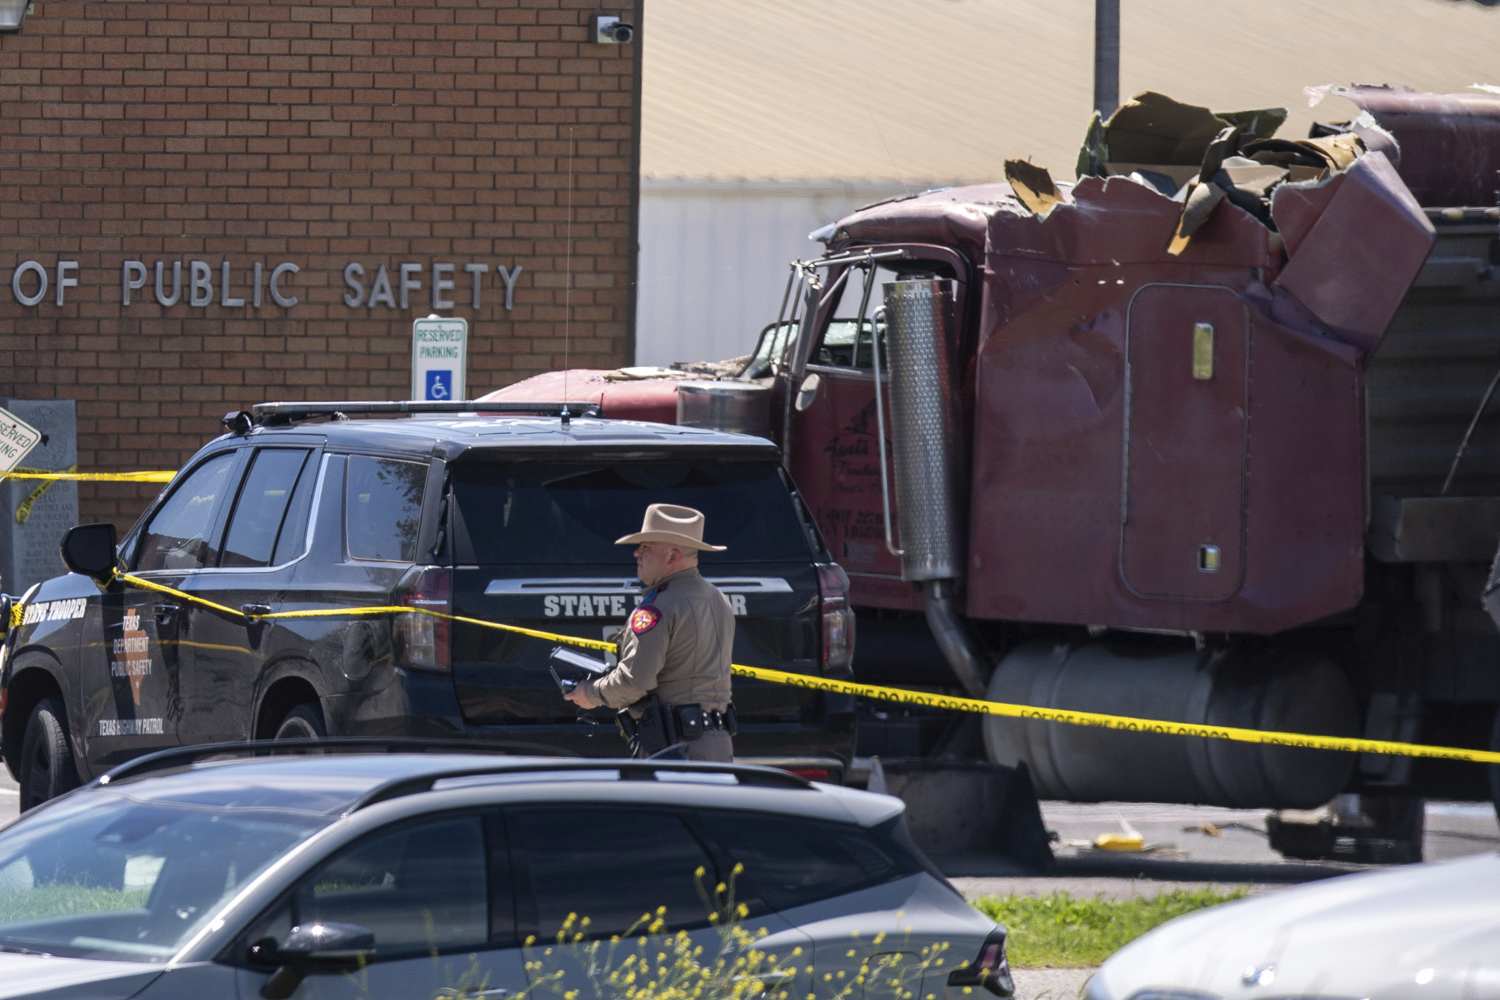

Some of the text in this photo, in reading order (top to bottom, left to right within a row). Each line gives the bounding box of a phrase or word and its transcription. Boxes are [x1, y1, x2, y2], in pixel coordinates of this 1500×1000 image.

[12, 259, 79, 308] OF
[122, 260, 300, 309] PUBLIC
[343, 262, 523, 311] SAFETY
[417, 329, 464, 342] RESERVED
[420, 346, 459, 359] PARKING
[47, 597, 87, 621] TROOPER
[544, 594, 626, 617] STATE
[122, 615, 140, 631] TEXAS
[113, 636, 149, 654] DEPARTMENT
[111, 659, 153, 677] PUBLIC SAFETY
[99, 719, 116, 736] TEXAS
[142, 717, 164, 735] PATROL
